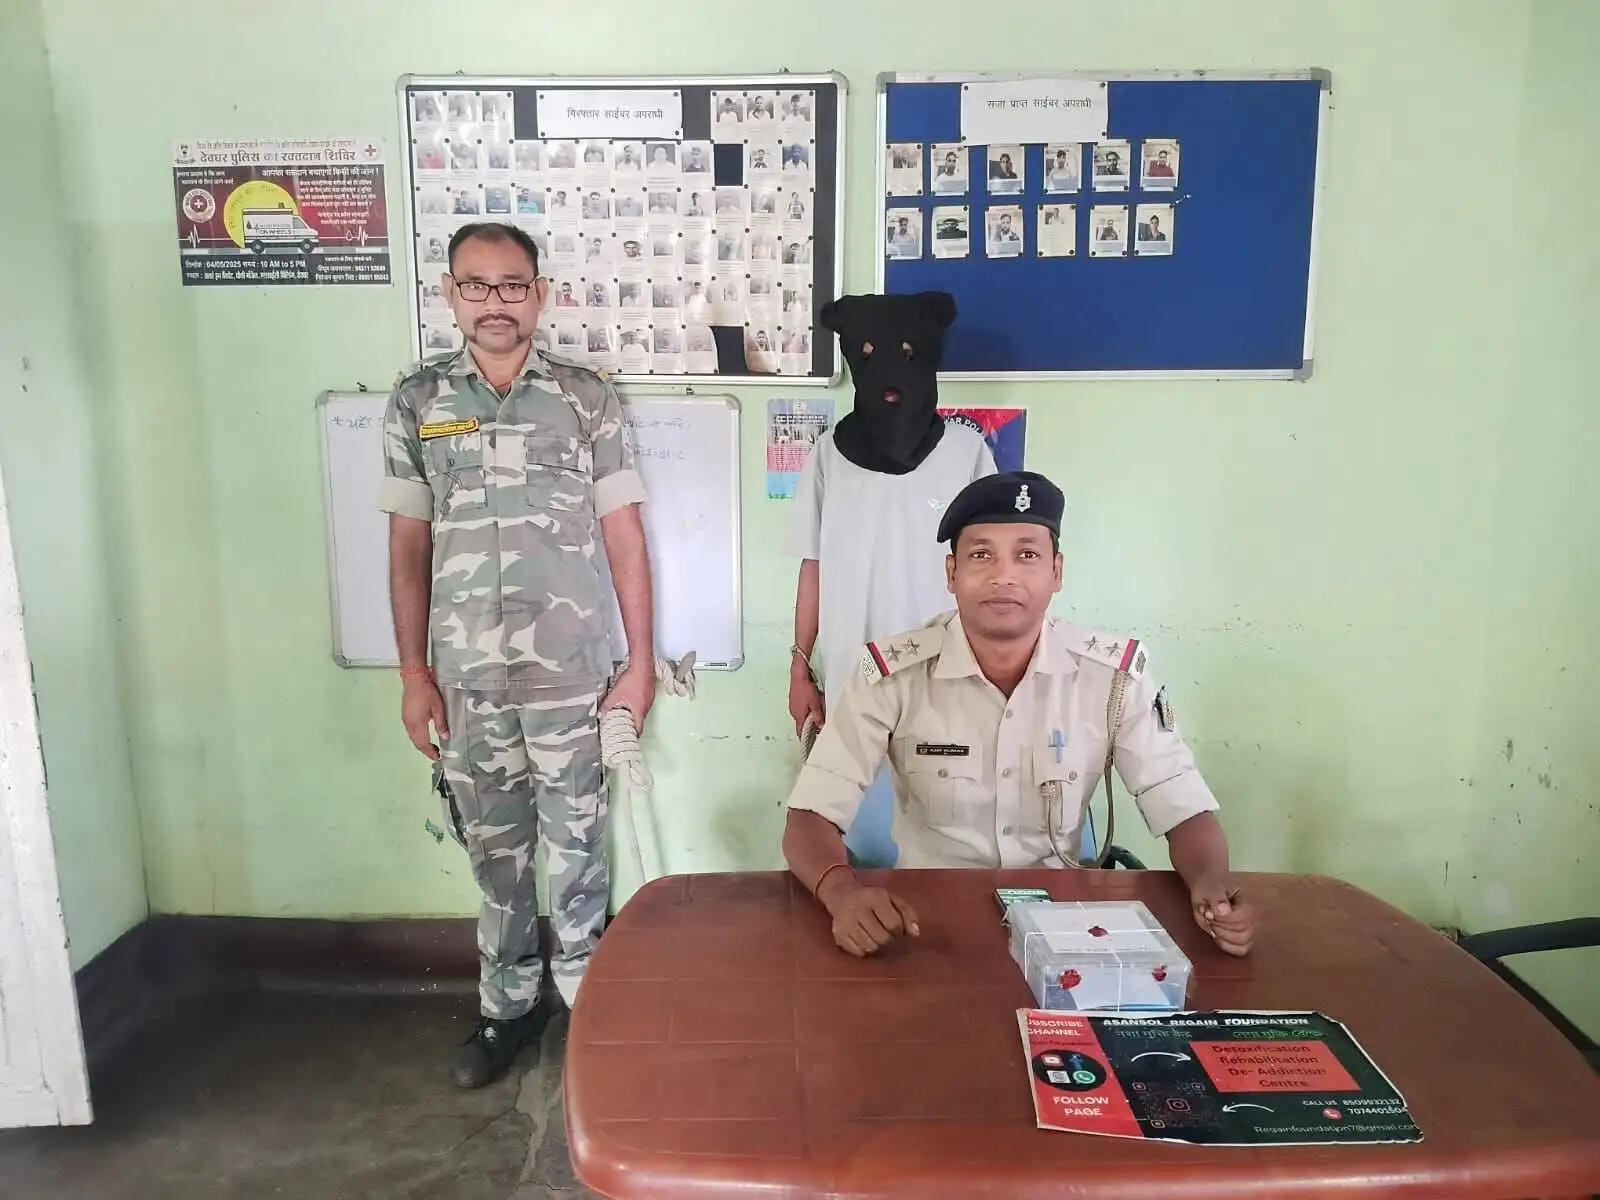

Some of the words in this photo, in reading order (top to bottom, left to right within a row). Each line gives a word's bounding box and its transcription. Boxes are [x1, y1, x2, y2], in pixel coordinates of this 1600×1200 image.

[987, 99, 1005, 108] सजा
[1010, 99, 1028, 109] प्राप्त
[1062, 97, 1092, 109] अपराधी
[634, 108, 663, 120] अपराधी
[200, 151, 227, 162] देवघर
[231, 149, 260, 165] पुलिस
[325, 148, 356, 161] शिविर
[1224, 1018, 1312, 1026] FOUNDATION
[1028, 1028, 1081, 1036] CHANNEL
[1211, 1045, 1311, 1053] Detoxification
[1219, 1056, 1320, 1064] Rehabilitation
[1258, 1068, 1327, 1076] Addiction
[1053, 1096, 1109, 1105] FOLLOW
[1064, 1107, 1103, 1116] PAGE
